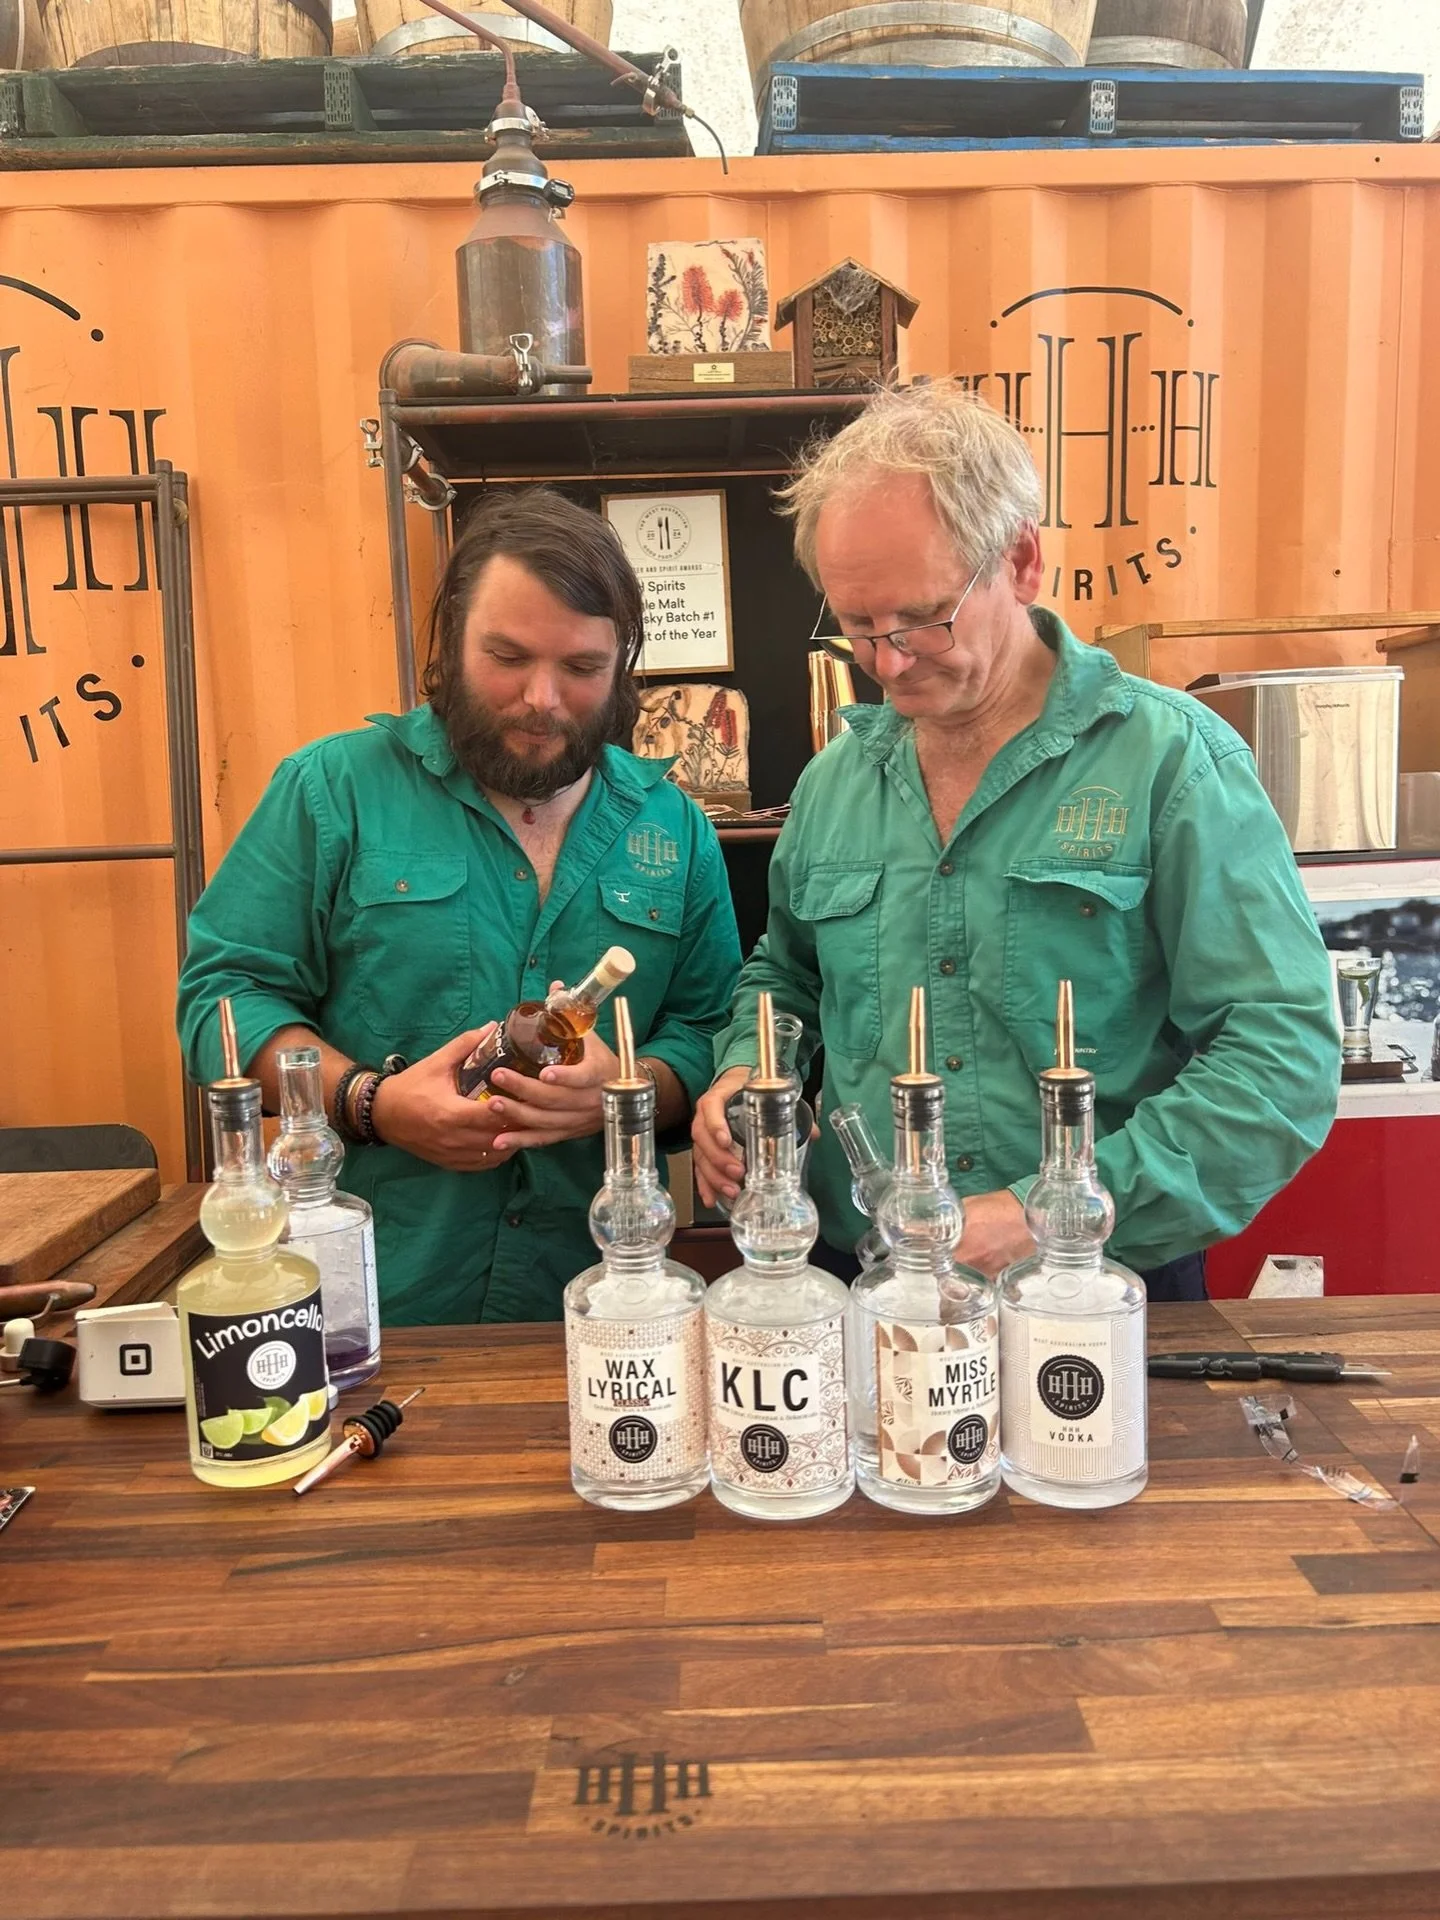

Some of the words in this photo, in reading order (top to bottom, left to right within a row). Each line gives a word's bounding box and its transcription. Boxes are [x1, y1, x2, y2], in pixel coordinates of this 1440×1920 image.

[659, 565, 678, 573] SPIRIT
[679, 564, 703, 572] AWARDS
[1052, 537, 1182, 601] IRITS
[647, 580, 686, 595] Spirits
[658, 598, 685, 610] Malt
[643, 611, 663, 627] sky
[666, 611, 700, 623] Batch
[702, 611, 716, 621] #1
[654, 629, 667, 641] of
[669, 630, 689, 640] the
[691, 627, 718, 639] Year
[1054, 797, 1130, 841] HHH
[627, 829, 679, 866] HHH
[1060, 841, 1114, 857] SPIRITS
[195, 1303, 323, 1360] Limoncello
[256, 1352, 289, 1376] HHH
[605, 1358, 656, 1380] WAX
[945, 1355, 988, 1384] MISS
[588, 1376, 677, 1401] LYRICAL
[721, 1361, 809, 1412] KLC
[928, 1371, 996, 1408] MYRTLE
[1047, 1370, 1094, 1401] HHH
[1054, 1398, 1088, 1412] SPIRITS
[616, 1426, 650, 1450] HHH
[747, 1435, 781, 1459] HHH
[955, 1426, 984, 1451] HHH
[1049, 1431, 1094, 1443] VODKA
[572, 1751, 713, 1816] HHH
[591, 1815, 694, 1840] SPIRITS
